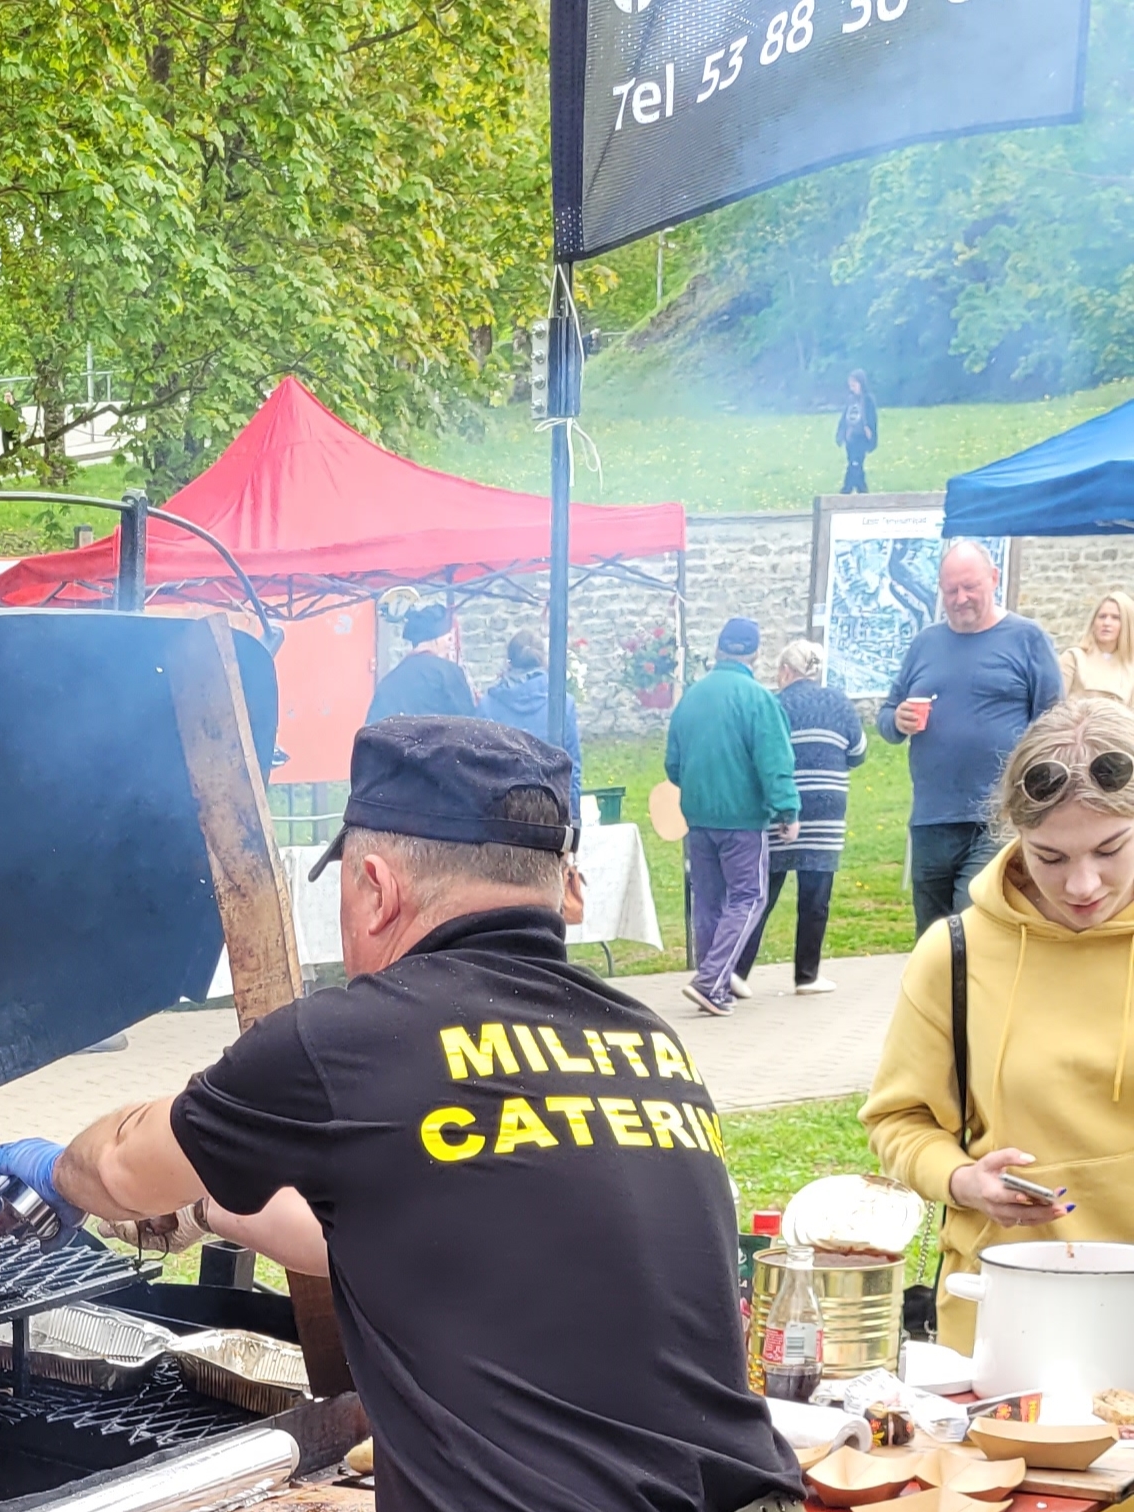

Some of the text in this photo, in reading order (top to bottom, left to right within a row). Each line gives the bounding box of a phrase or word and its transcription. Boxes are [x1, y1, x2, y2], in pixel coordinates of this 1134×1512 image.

[612, 62, 675, 131] Tel
[695, 35, 749, 104] 53
[759, 0, 815, 66] 88
